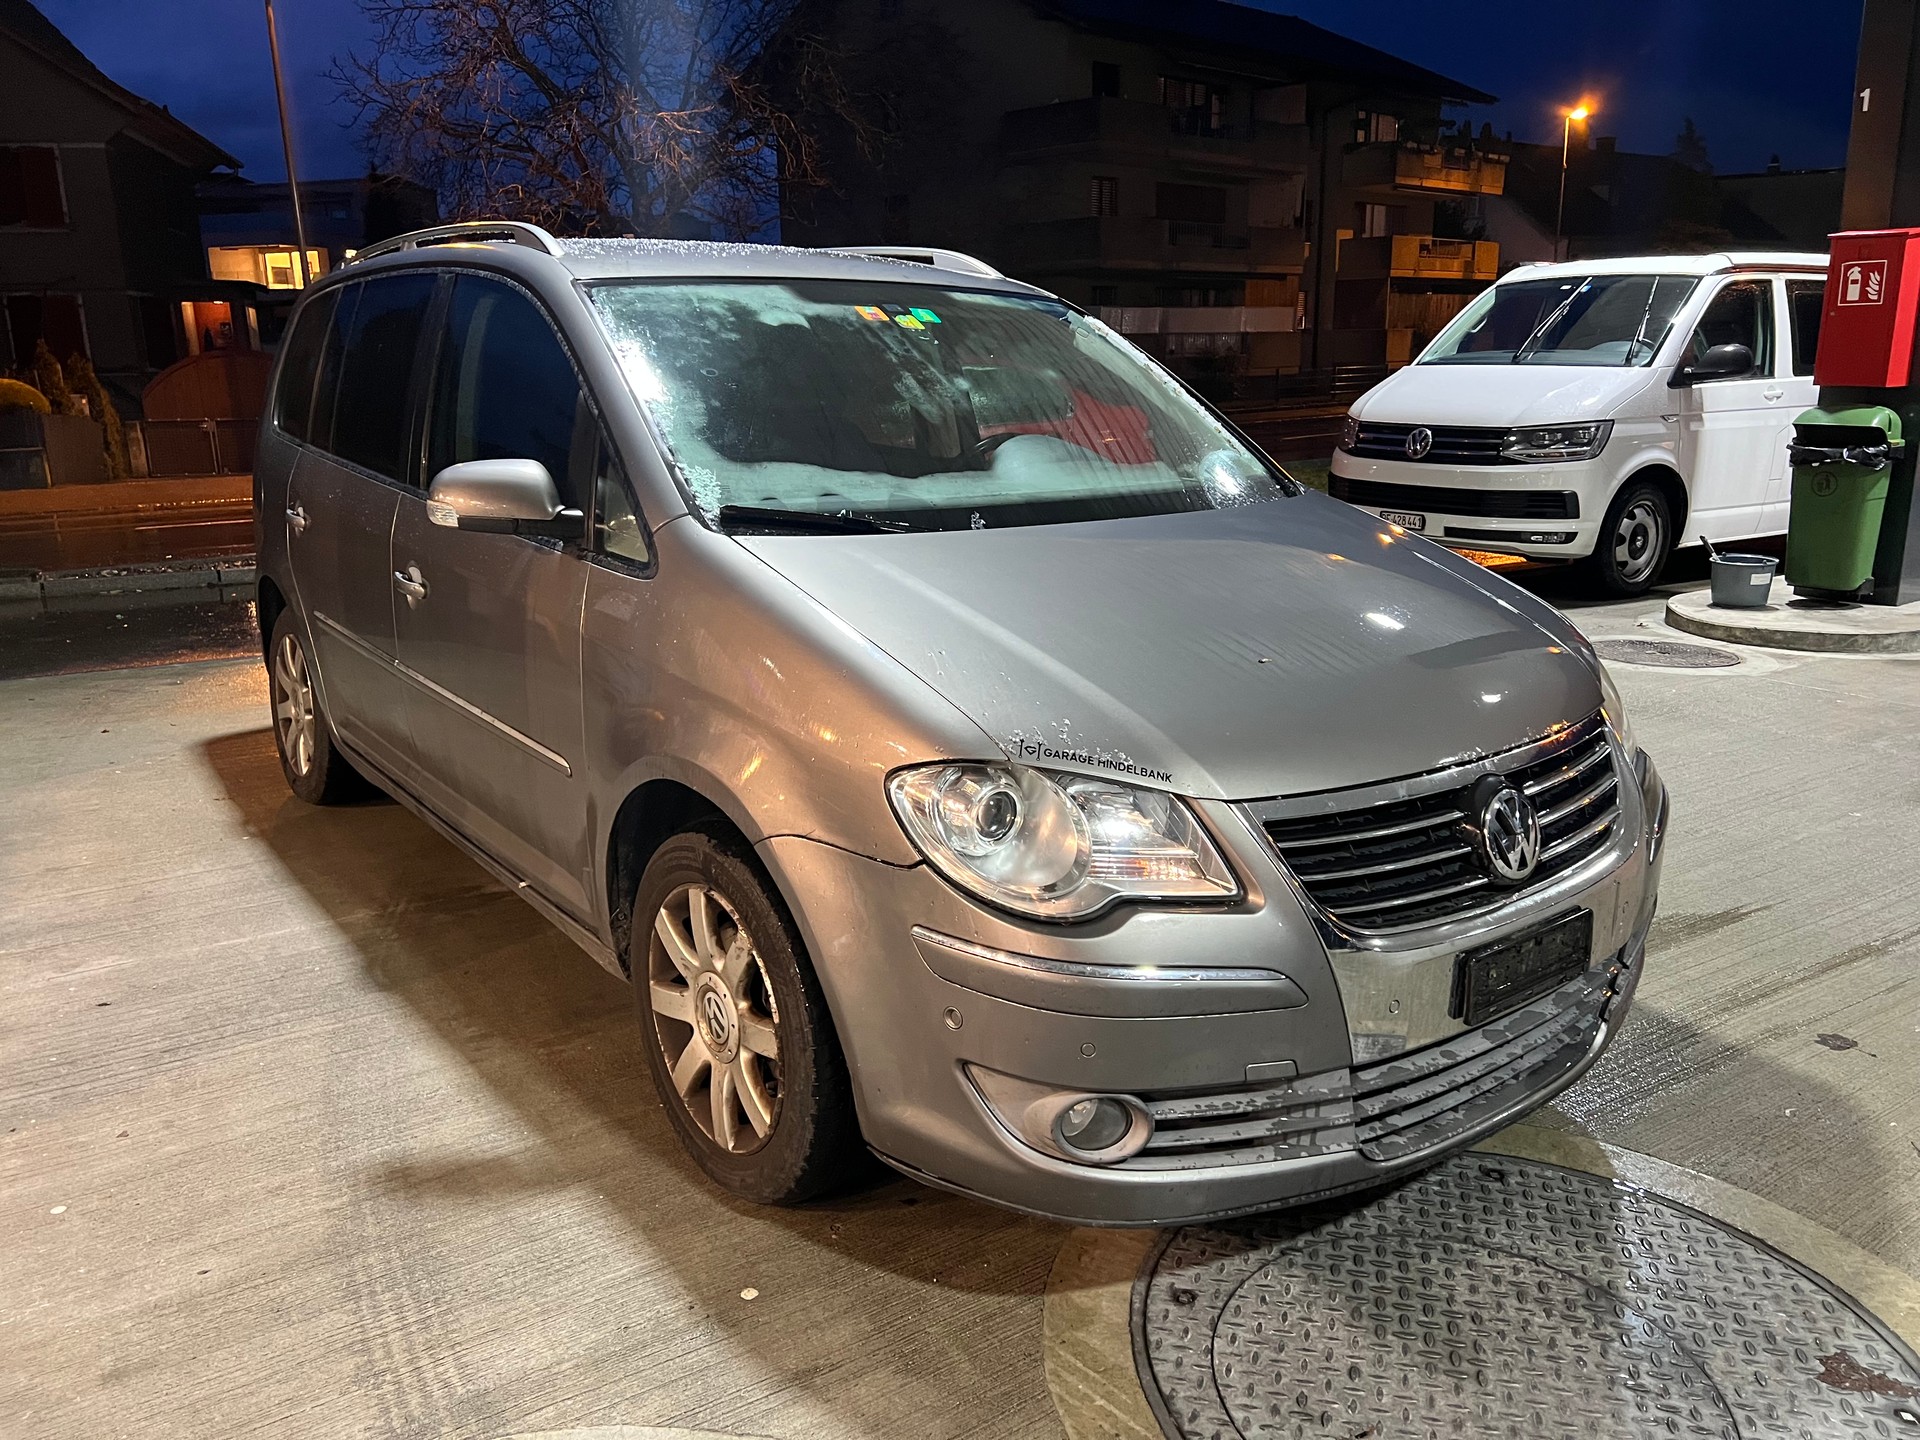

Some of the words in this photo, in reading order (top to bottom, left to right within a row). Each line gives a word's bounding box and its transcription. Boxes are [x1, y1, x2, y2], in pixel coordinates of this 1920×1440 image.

[1860, 88, 1870, 112] 1
[1043, 748, 1094, 766] GARAGE
[1097, 759, 1173, 783] HINDELBANK
